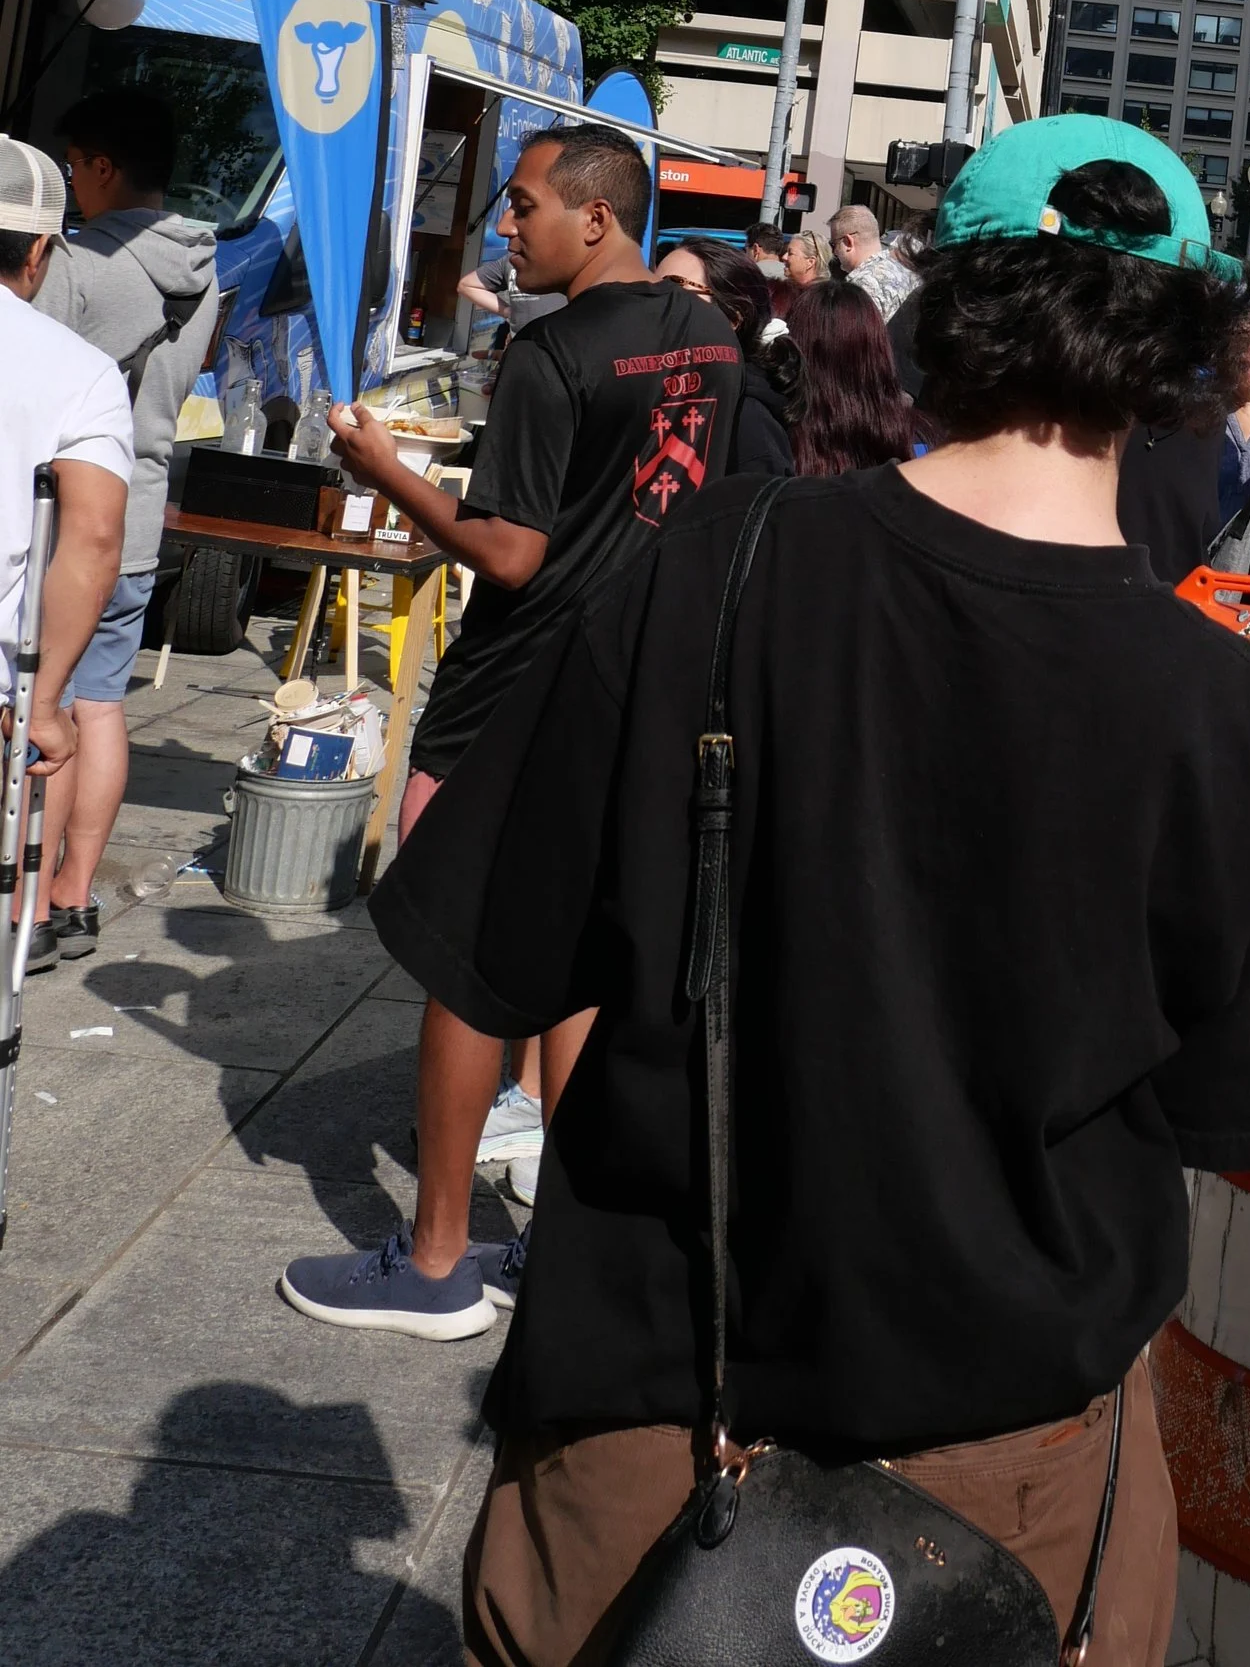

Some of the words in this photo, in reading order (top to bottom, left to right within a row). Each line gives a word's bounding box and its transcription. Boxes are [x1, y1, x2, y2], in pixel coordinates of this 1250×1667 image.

[726, 47, 768, 63] ATLANTIC
[377, 530, 408, 540] TRUVIA
[800, 1567, 820, 1602] DROVE
[861, 1556, 889, 1589] BOSTON
[883, 1593, 891, 1621] DUCK
[857, 1625, 885, 1652] TOURS
